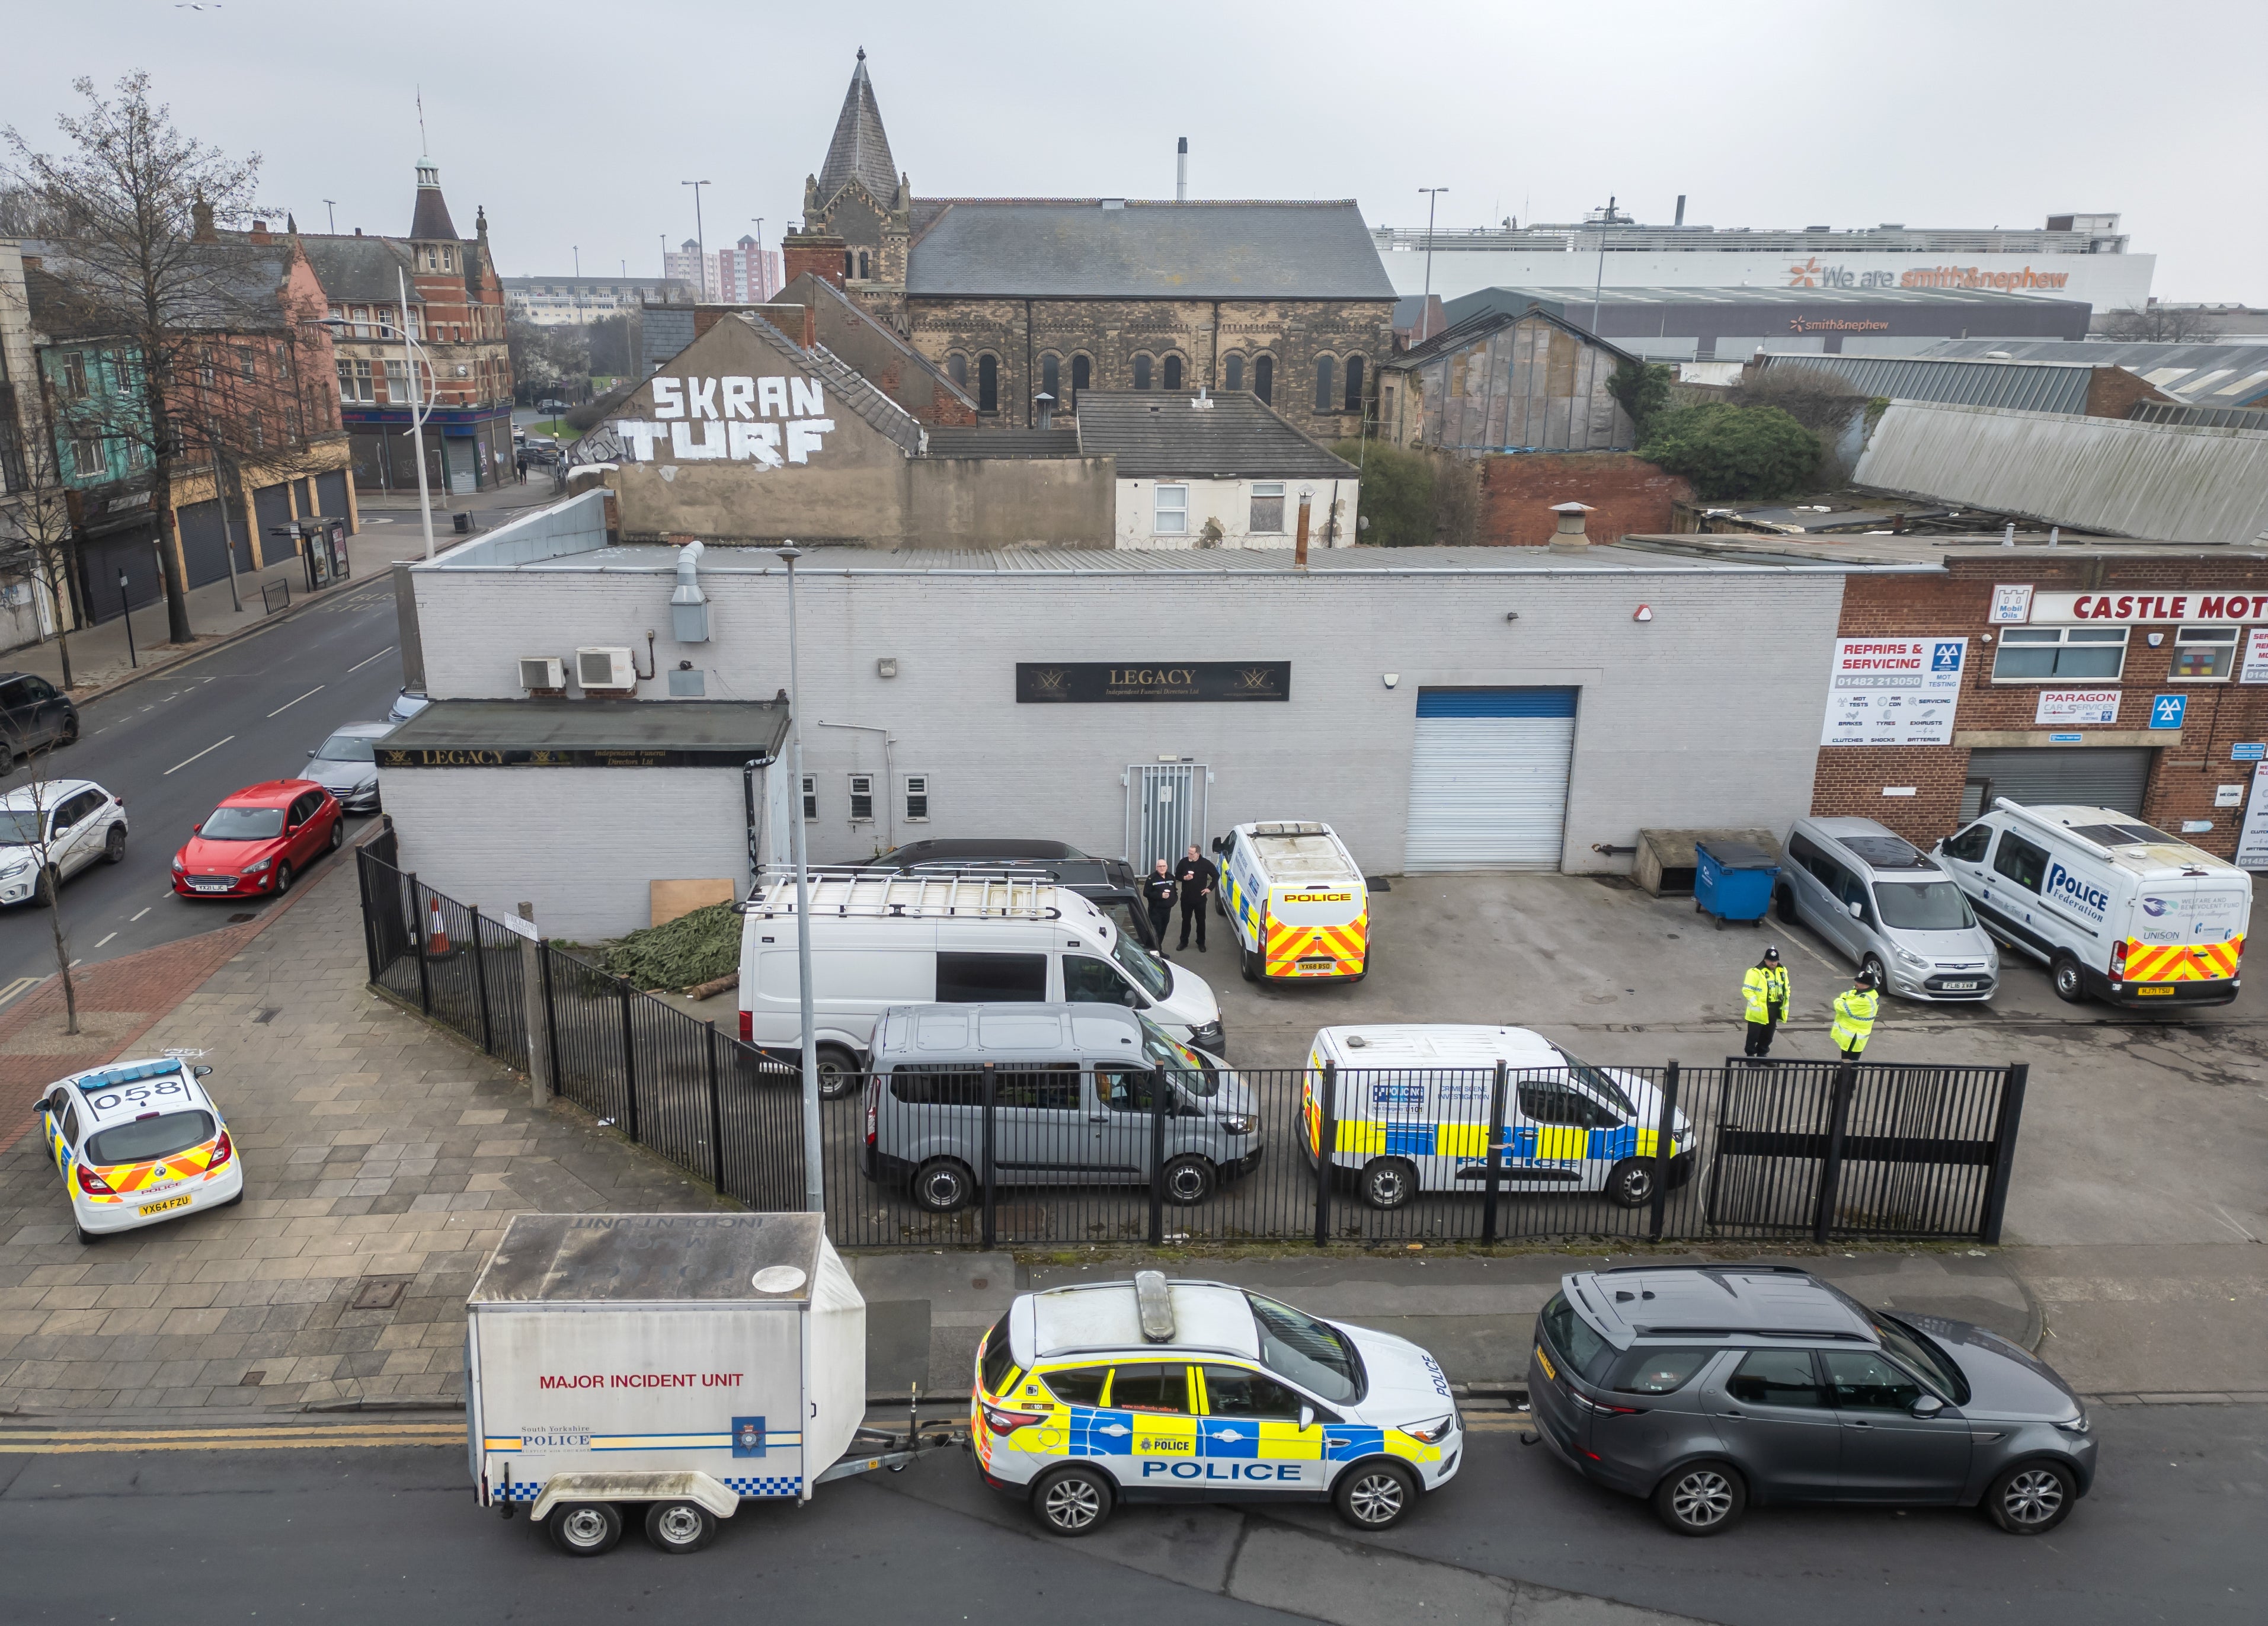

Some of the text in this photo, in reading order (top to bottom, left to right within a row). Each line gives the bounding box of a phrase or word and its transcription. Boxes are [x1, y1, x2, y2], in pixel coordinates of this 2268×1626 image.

[1823, 265, 2068, 293] We are smith&nephew
[1805, 319, 1889, 332] smith&nephew
[652, 376, 824, 420] SKRAN
[618, 419, 835, 469] TURF
[348, 593, 396, 602] BUS
[322, 603, 380, 613] STO
[2074, 596, 2268, 619] CASTLE MOT
[1844, 644, 1923, 654] REPAIRS &
[1842, 659, 1921, 669] SERVICING
[1109, 670, 1197, 684] LEGACY
[1877, 677, 1921, 685] 213050
[2068, 703, 2114, 713] SERVICES
[421, 750, 505, 764] LEGACY
[2047, 862, 2109, 912] POLICE
[2053, 889, 2103, 923] Federation
[505, 913, 536, 932] STRICKLAND
[513, 924, 529, 937] STREET
[94, 1081, 181, 1110] 058
[1386, 1087, 1423, 1096] POLICNG
[141, 1182, 181, 1195] POLICE
[143, 1196, 188, 1214] YX64 FZU
[539, 1373, 744, 1389] MAJOR INCIDENT UNIT
[1421, 1355, 1450, 1397] POLICE
[522, 1435, 590, 1446] POLICE
[1154, 1441, 1189, 1450] POLICE
[1143, 1461, 1301, 1481] POLICE
